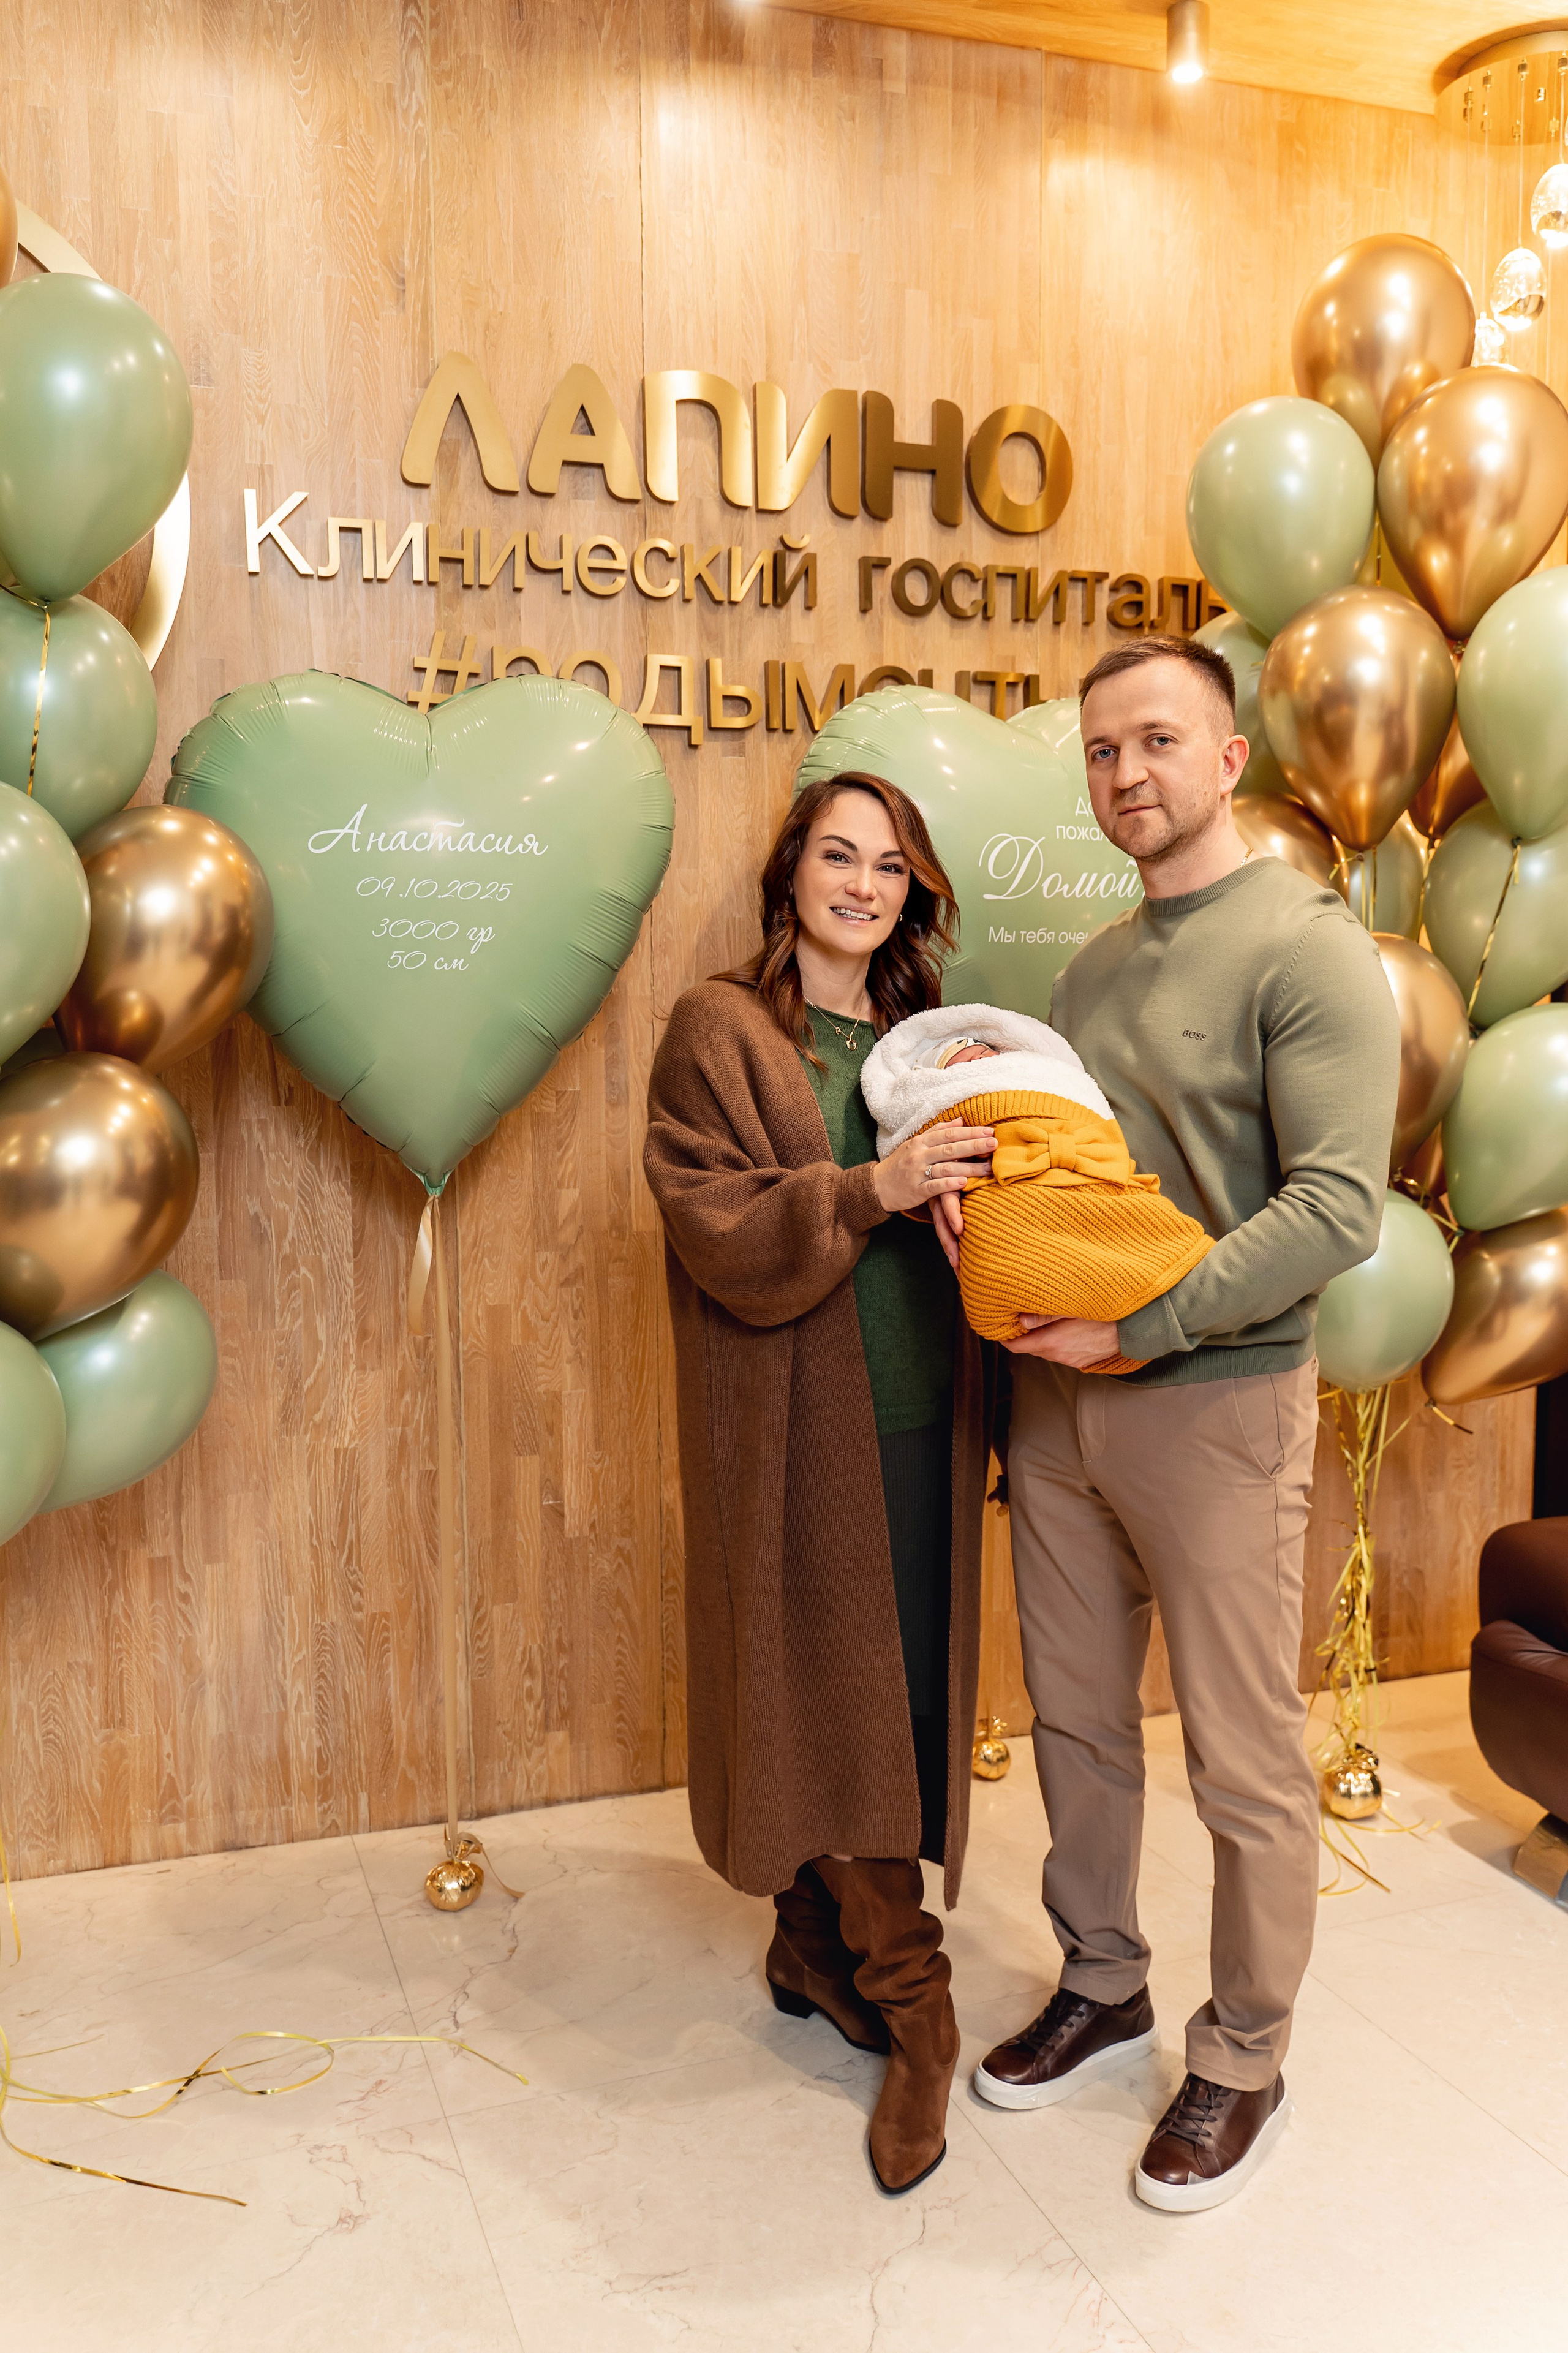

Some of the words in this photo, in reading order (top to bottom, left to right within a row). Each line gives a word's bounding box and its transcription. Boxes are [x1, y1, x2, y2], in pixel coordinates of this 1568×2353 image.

[401, 350, 1074, 534] ЛАПИНО
[243, 488, 818, 608] Клинический
[307, 803, 549, 856] Анастасия
[356, 877, 513, 901] 09.10.2025
[372, 918, 459, 940] 3000
[466, 925, 496, 954] гр
[988, 926, 1016, 943] Мы
[1019, 927, 1055, 944] тебя
[387, 950, 427, 970] 50
[434, 957, 469, 971] см
[1182, 1028, 1207, 1041] BOSS
